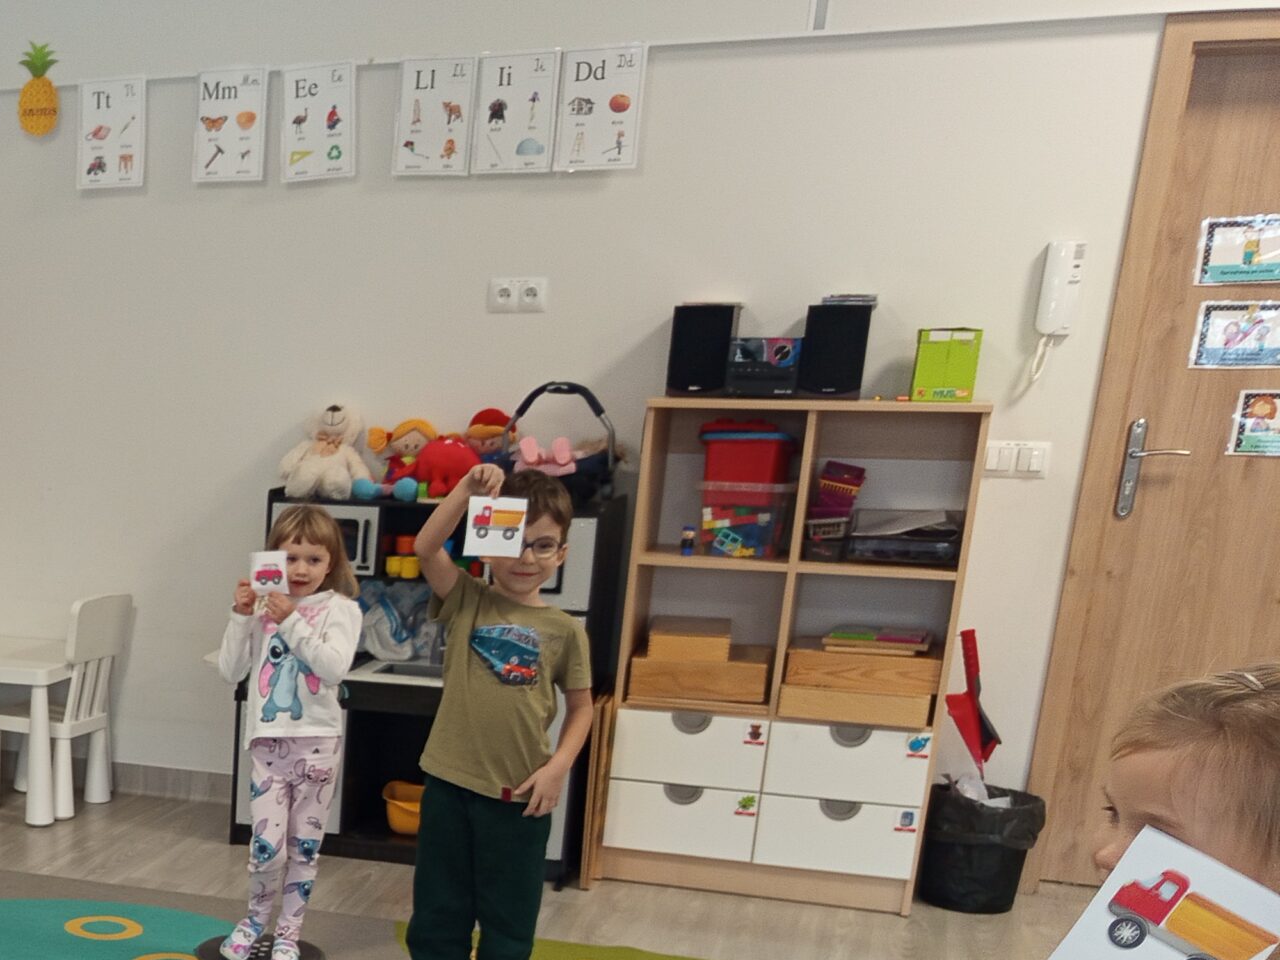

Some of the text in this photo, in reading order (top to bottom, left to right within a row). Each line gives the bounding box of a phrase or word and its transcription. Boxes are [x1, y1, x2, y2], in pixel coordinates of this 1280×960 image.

[414, 69, 436, 90] Ll
[498, 65, 512, 87] Ii
[574, 59, 606, 82] Dd
[202, 81, 239, 101] Mm
[294, 79, 319, 99] Ee
[92, 91, 112, 110] Tt
